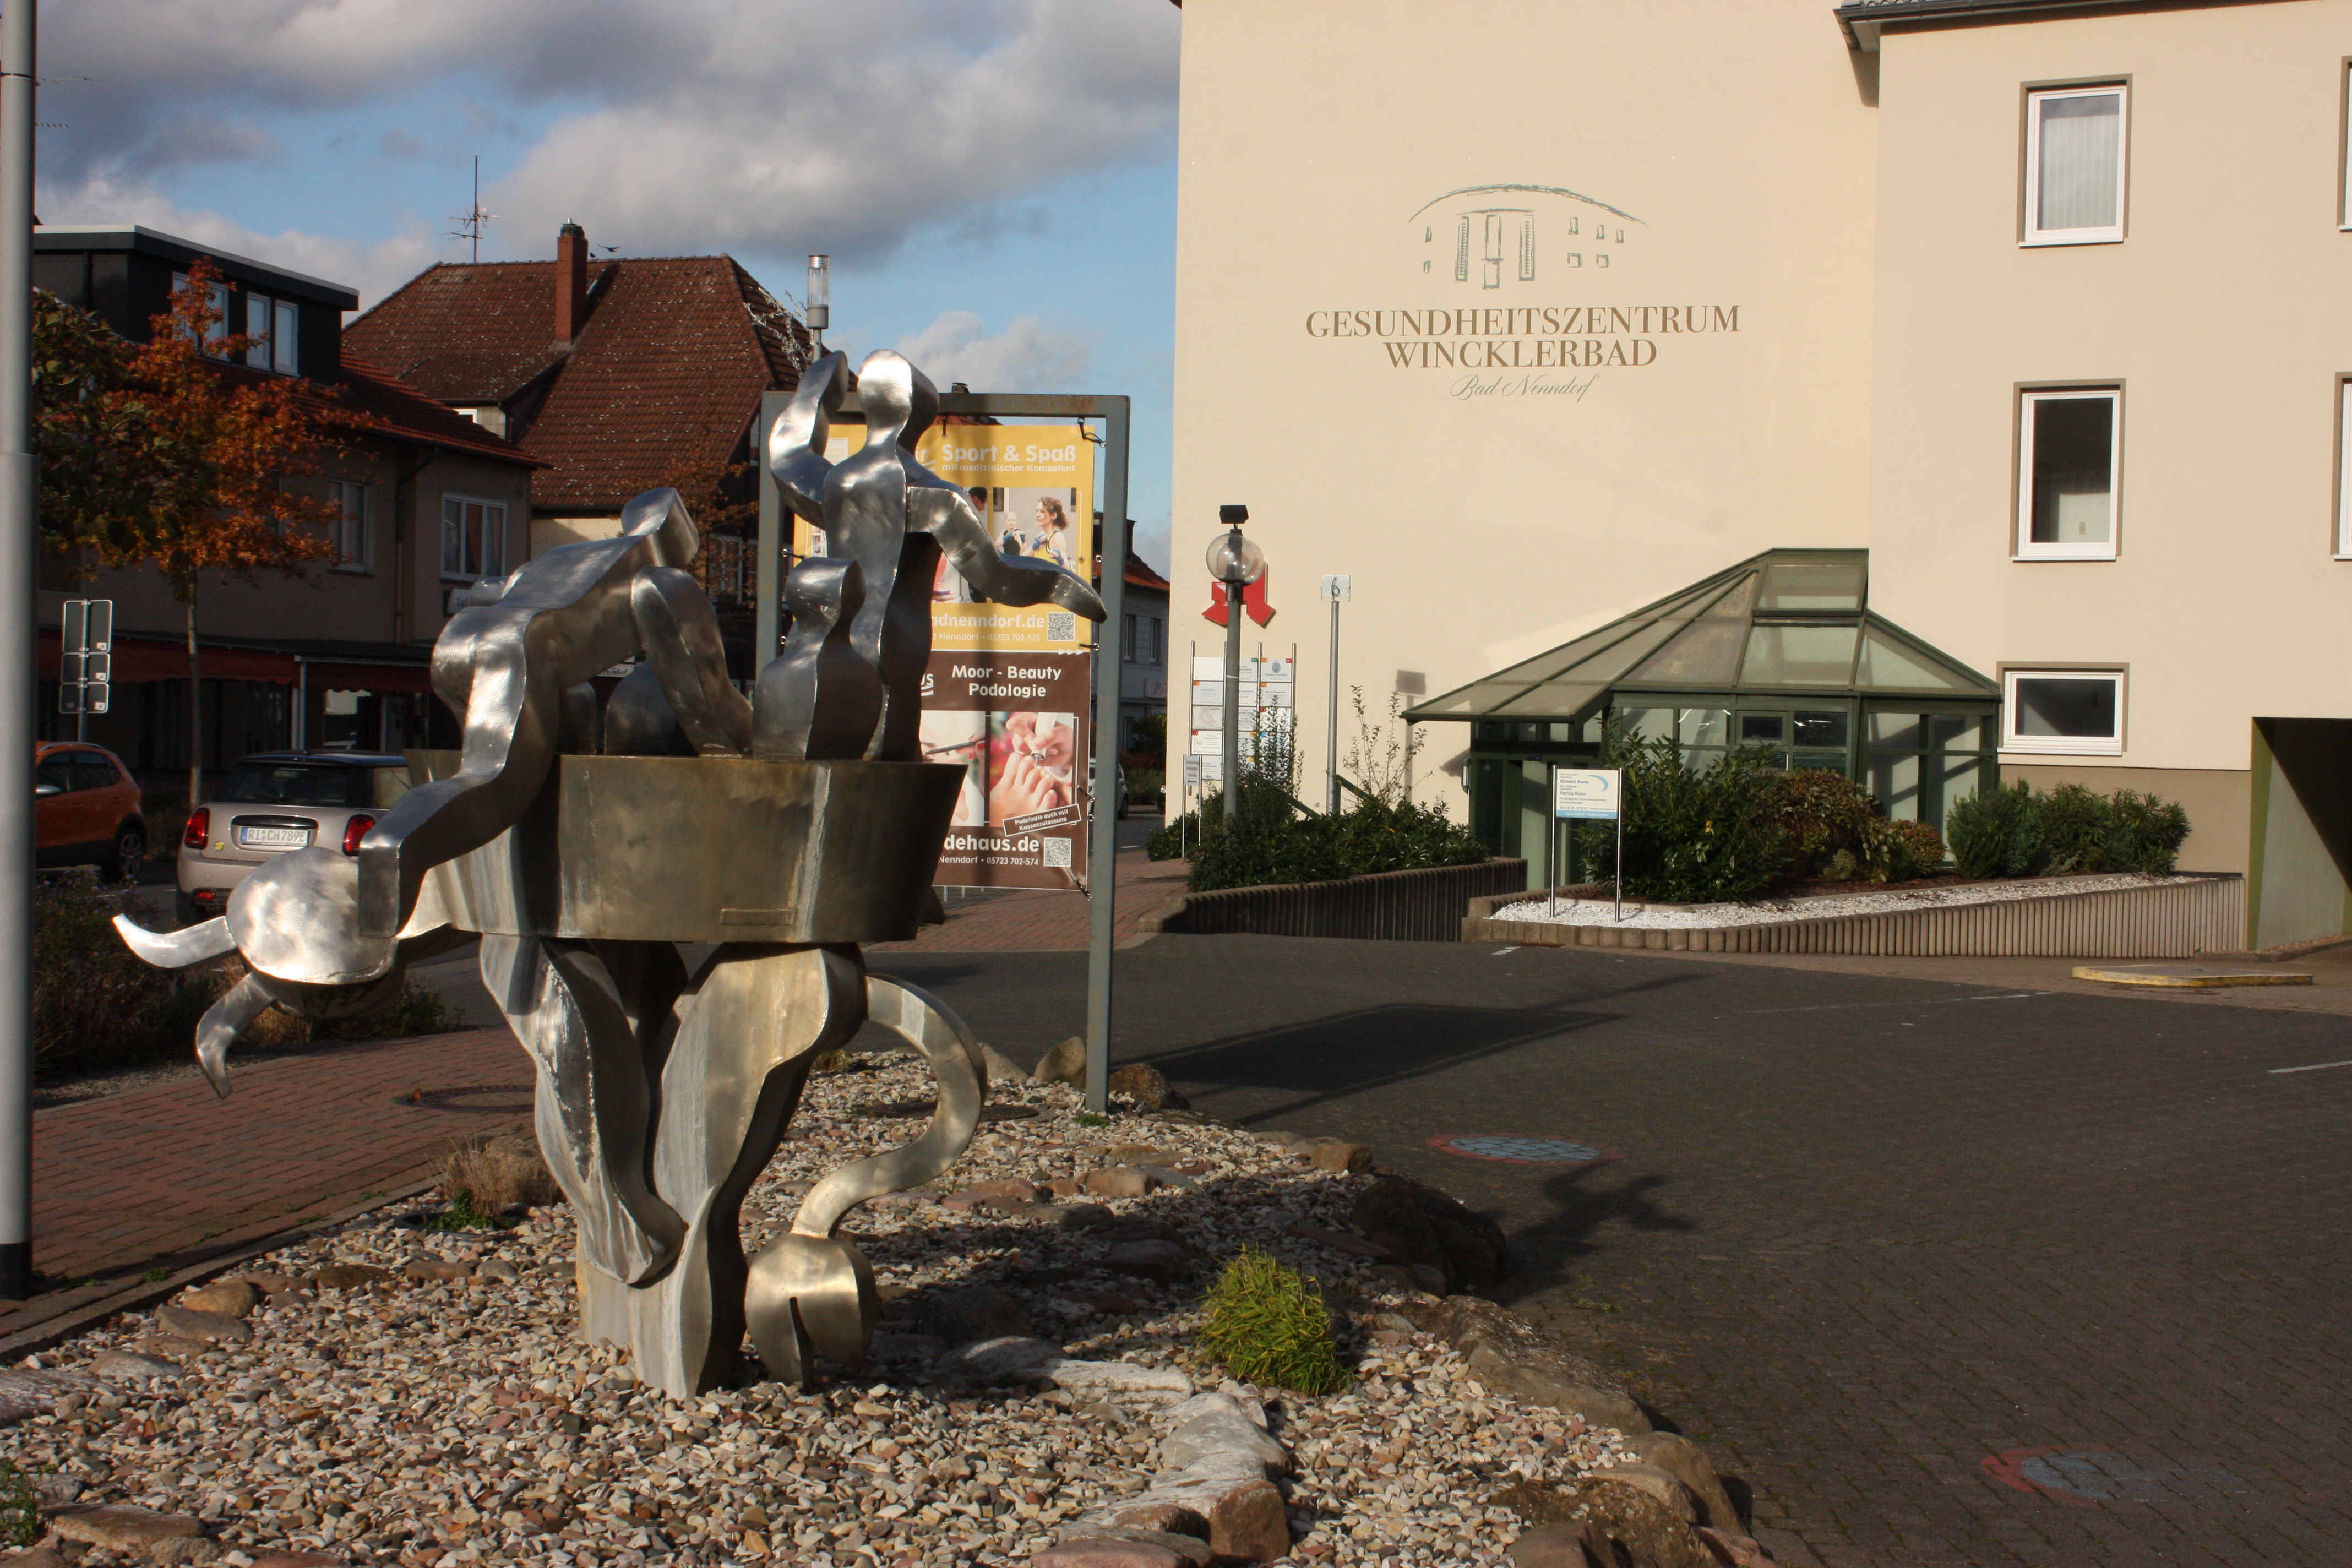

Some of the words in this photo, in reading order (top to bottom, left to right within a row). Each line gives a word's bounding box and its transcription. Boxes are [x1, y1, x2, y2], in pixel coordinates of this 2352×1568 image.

[1306, 304, 1741, 337] GESUNDHEITSZENTRUM
[1383, 339, 1658, 368] WINCKLERBAD
[1450, 374, 1499, 400] Bad
[1502, 374, 1600, 403] Nenndorf
[942, 444, 998, 462] Sport
[1004, 444, 1019, 461] &
[1026, 444, 1076, 463] Spaß
[960, 464, 1023, 472] medizinischer
[1027, 464, 1076, 472] Kompetenz
[951, 665, 993, 678] Moor
[1008, 666, 1062, 680] Beauty
[968, 683, 1046, 698] Podologie
[1015, 814, 1043, 825] Podologie
[1019, 816, 1067, 831] Kassenzulassung
[987, 856, 1008, 864] 05723
[1010, 857, 1038, 865] 702-574
